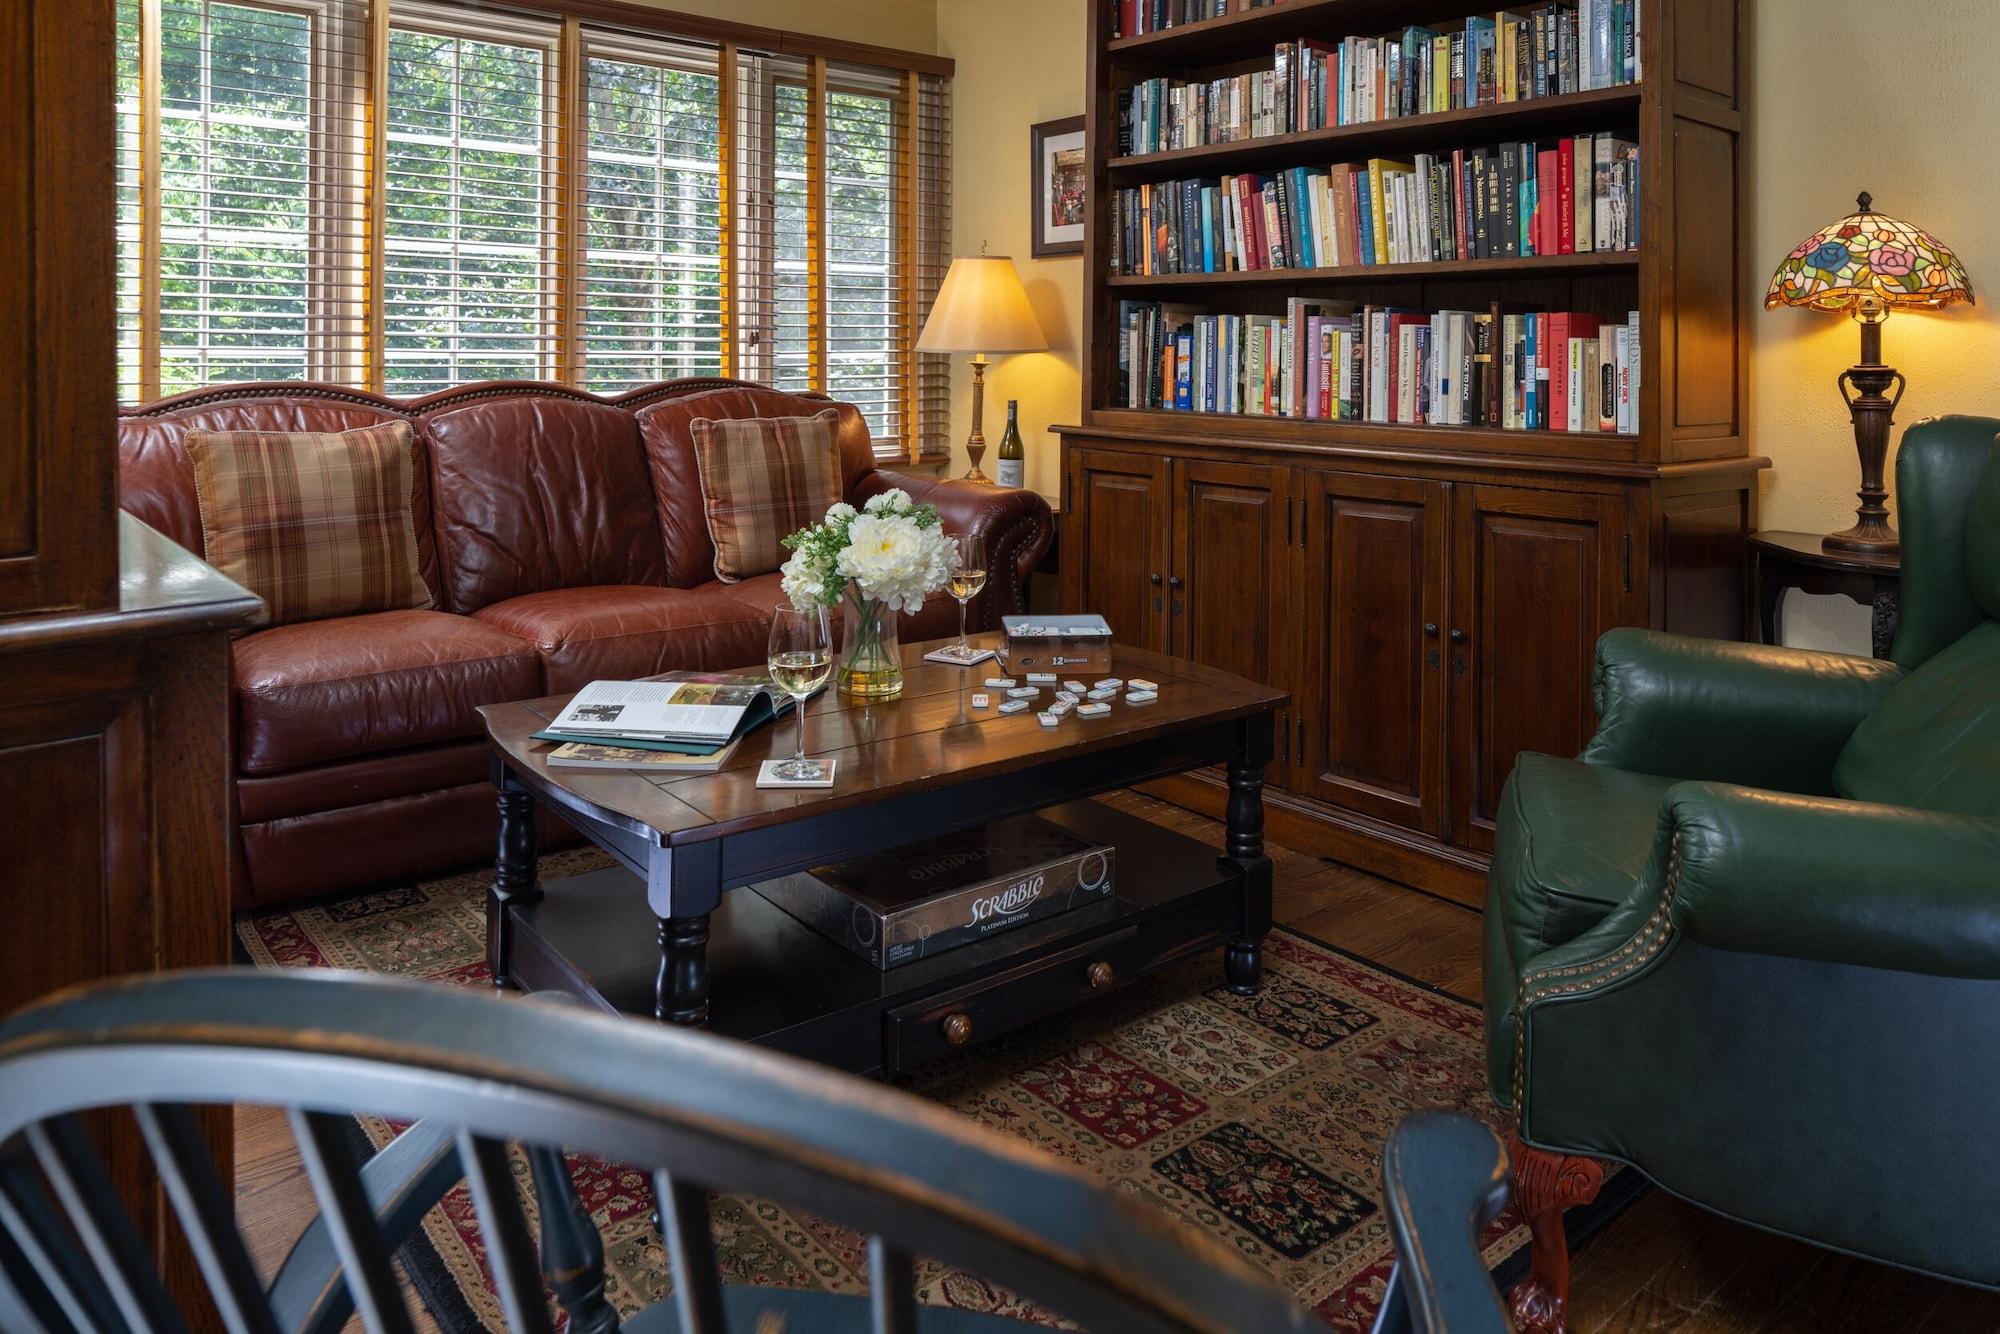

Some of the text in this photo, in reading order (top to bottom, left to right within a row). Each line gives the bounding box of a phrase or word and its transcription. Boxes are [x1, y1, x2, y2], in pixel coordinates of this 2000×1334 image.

[1451, 39, 1463, 53] THE
[1451, 55, 1463, 78] RUINS
[1537, 64, 1545, 79] NEON
[1476, 177, 1484, 220] NEANDERTHAL
[1630, 324, 1639, 365] BIRDS
[1320, 359, 1331, 393] Fantastic
[1463, 374, 1469, 383] TO
[1052, 657, 1064, 666] 12
[965, 875, 1044, 928] SCRABBLE
[980, 912, 1029, 932] PLATINUM EDITION
